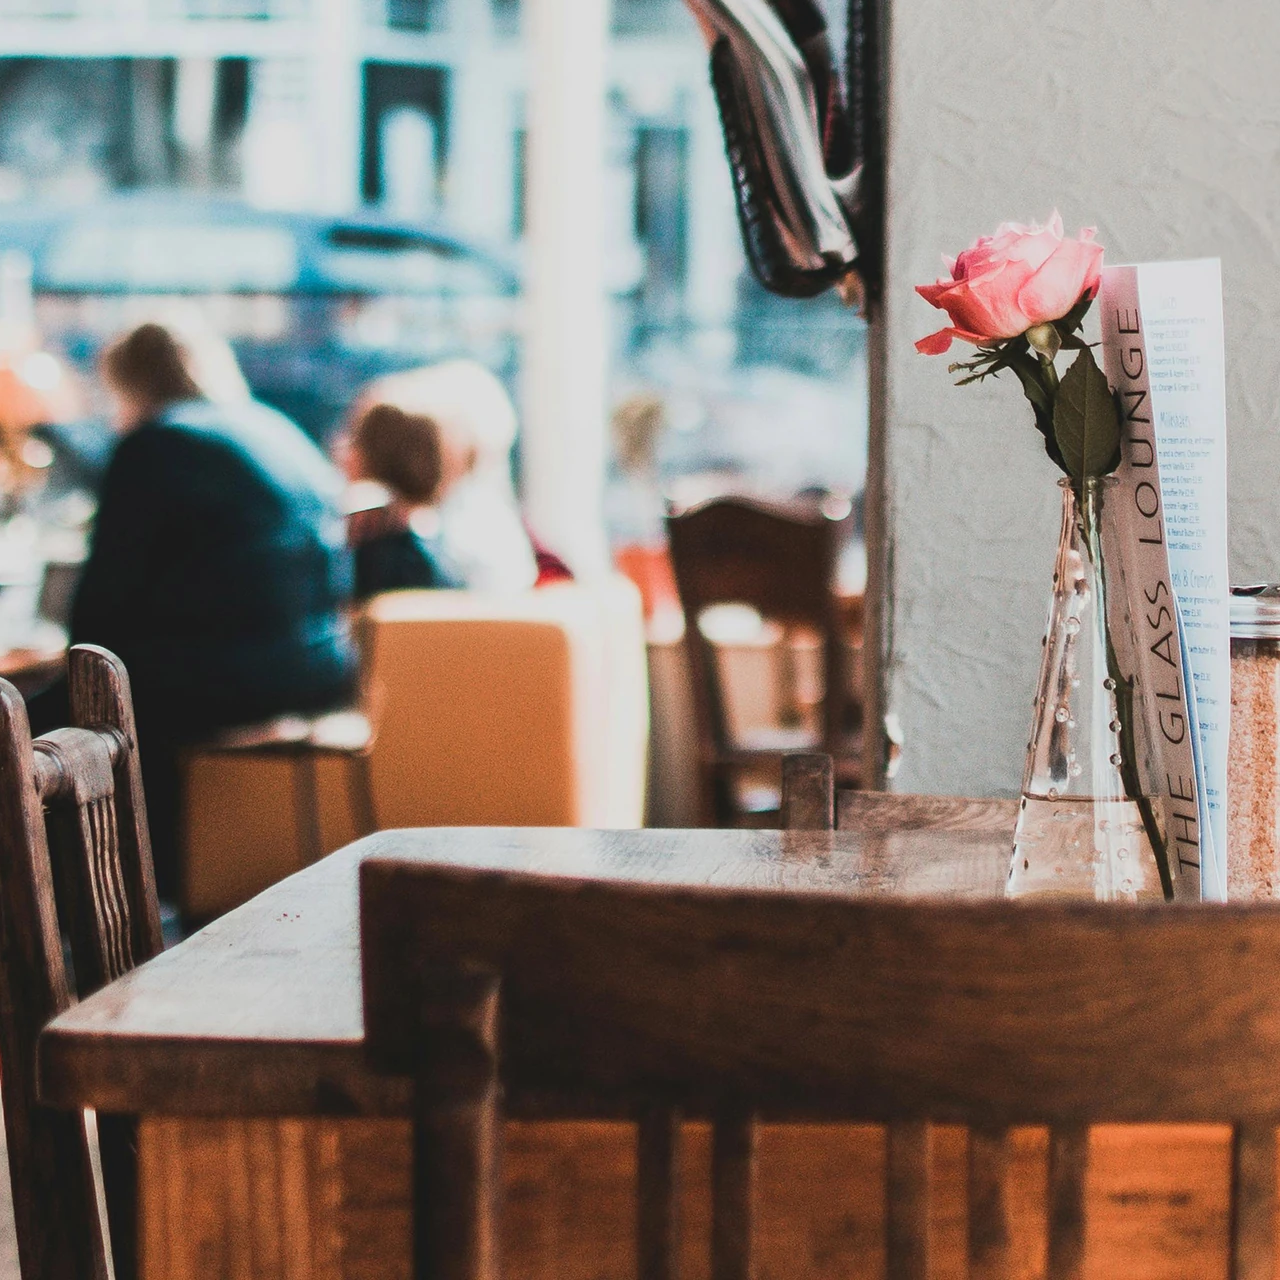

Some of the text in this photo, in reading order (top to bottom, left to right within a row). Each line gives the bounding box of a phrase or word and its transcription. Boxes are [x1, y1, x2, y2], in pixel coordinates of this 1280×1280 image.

[1114, 307, 1165, 546] LOUNGE
[1142, 579, 1188, 746] GLASS
[1166, 772, 1200, 875] THE
